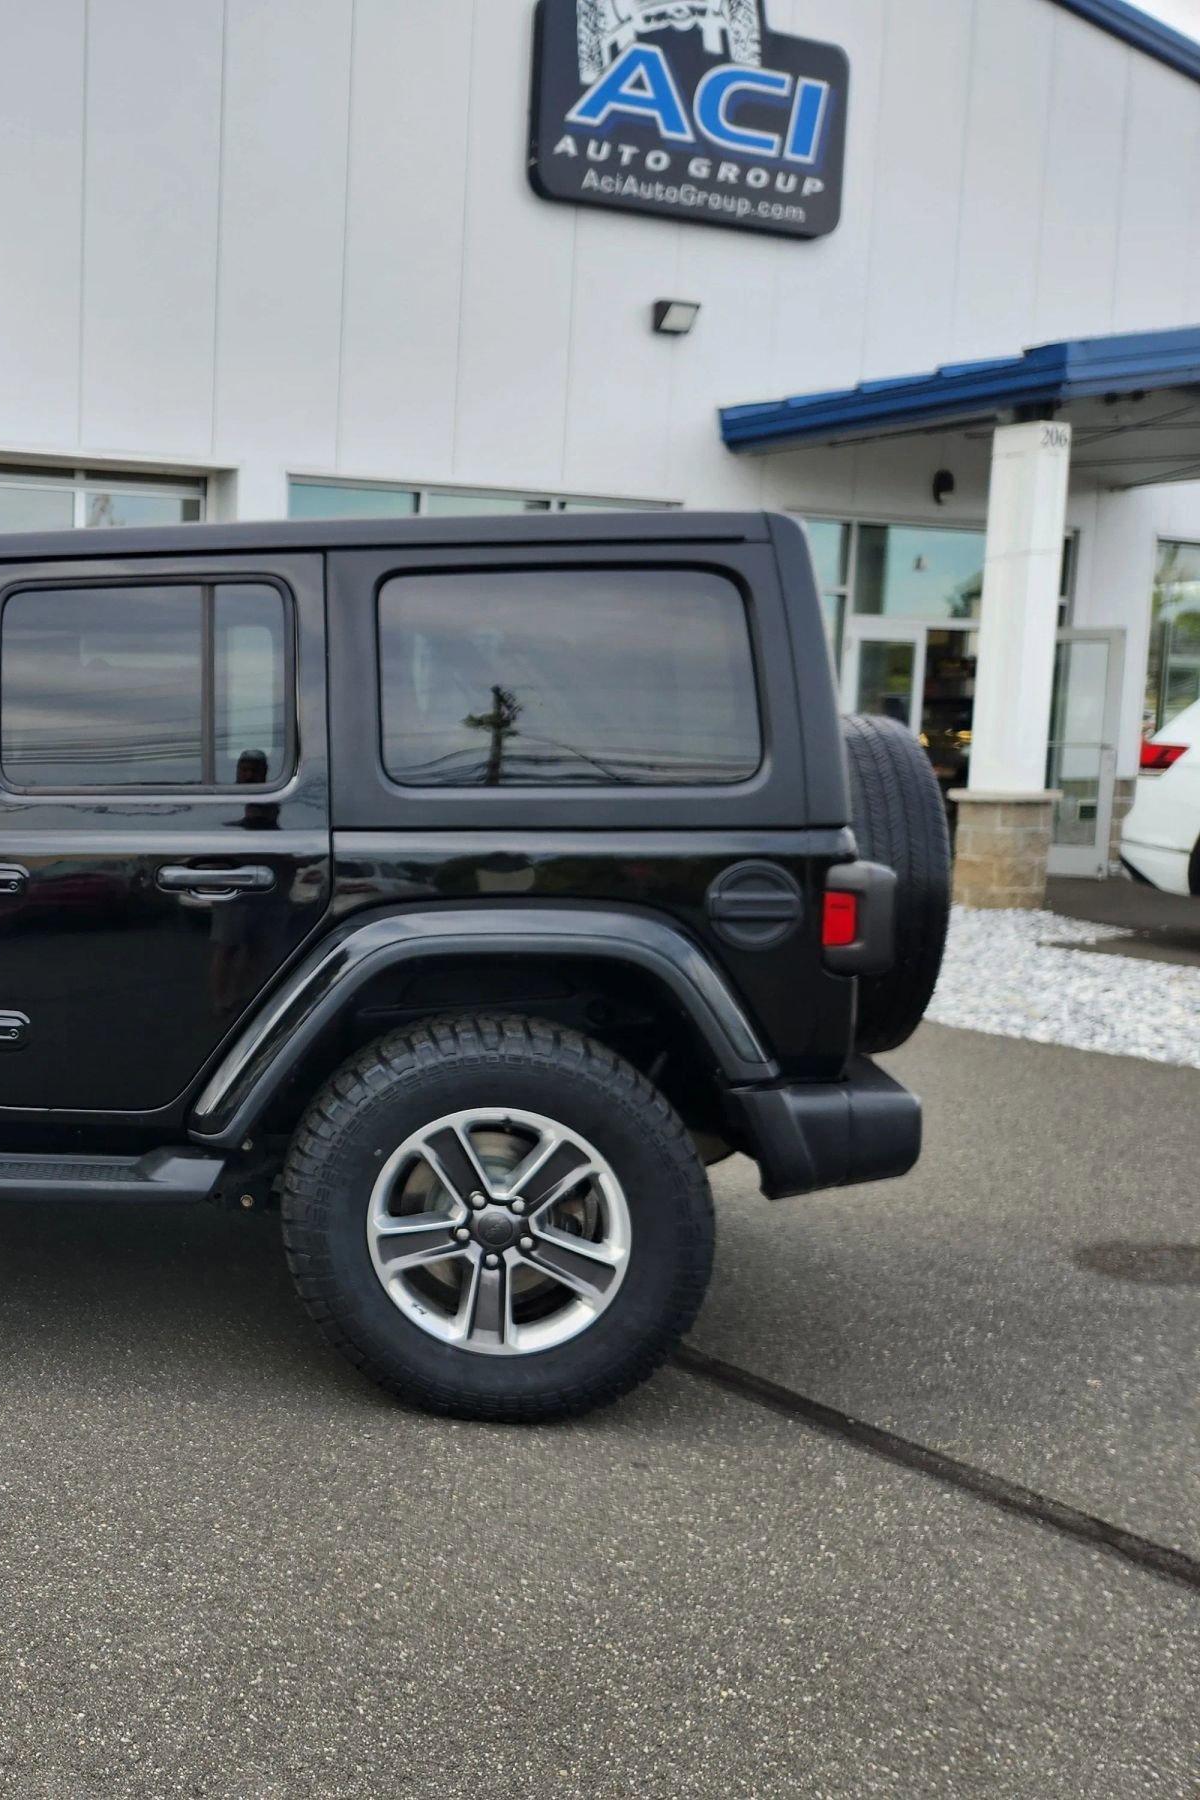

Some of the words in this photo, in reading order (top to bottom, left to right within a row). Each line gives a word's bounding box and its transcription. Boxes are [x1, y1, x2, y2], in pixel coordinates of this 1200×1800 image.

[565, 43, 830, 164] ACI
[554, 135, 670, 172] AUTO
[688, 157, 824, 197] GROUP
[582, 169, 805, 222] AciAutoGroup.com
[1040, 425, 1068, 448] 206
